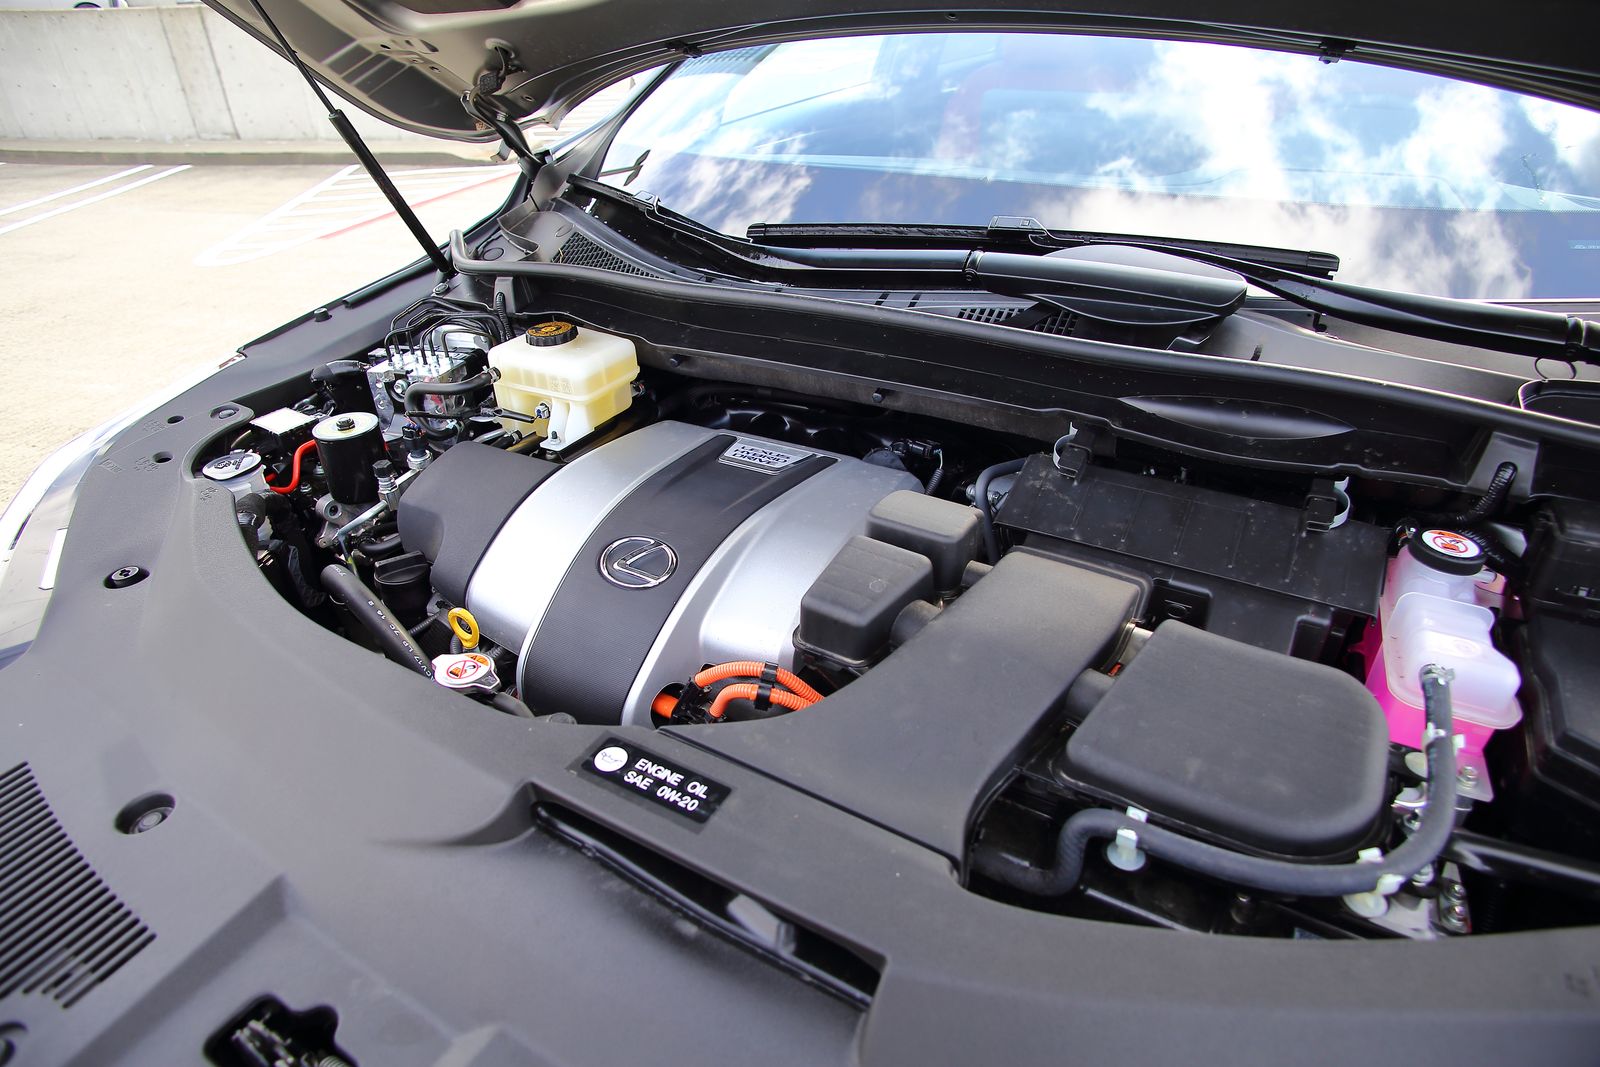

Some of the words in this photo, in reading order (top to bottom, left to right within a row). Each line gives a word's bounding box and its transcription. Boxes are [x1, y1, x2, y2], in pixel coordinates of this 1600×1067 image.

[732, 453, 778, 465] DRIVE
[734, 449, 788, 463] HYBRID
[623, 770, 653, 791] SAE
[656, 786, 700, 812] 0W-20
[634, 757, 685, 787] ENGINE
[686, 781, 709, 799] OIL
